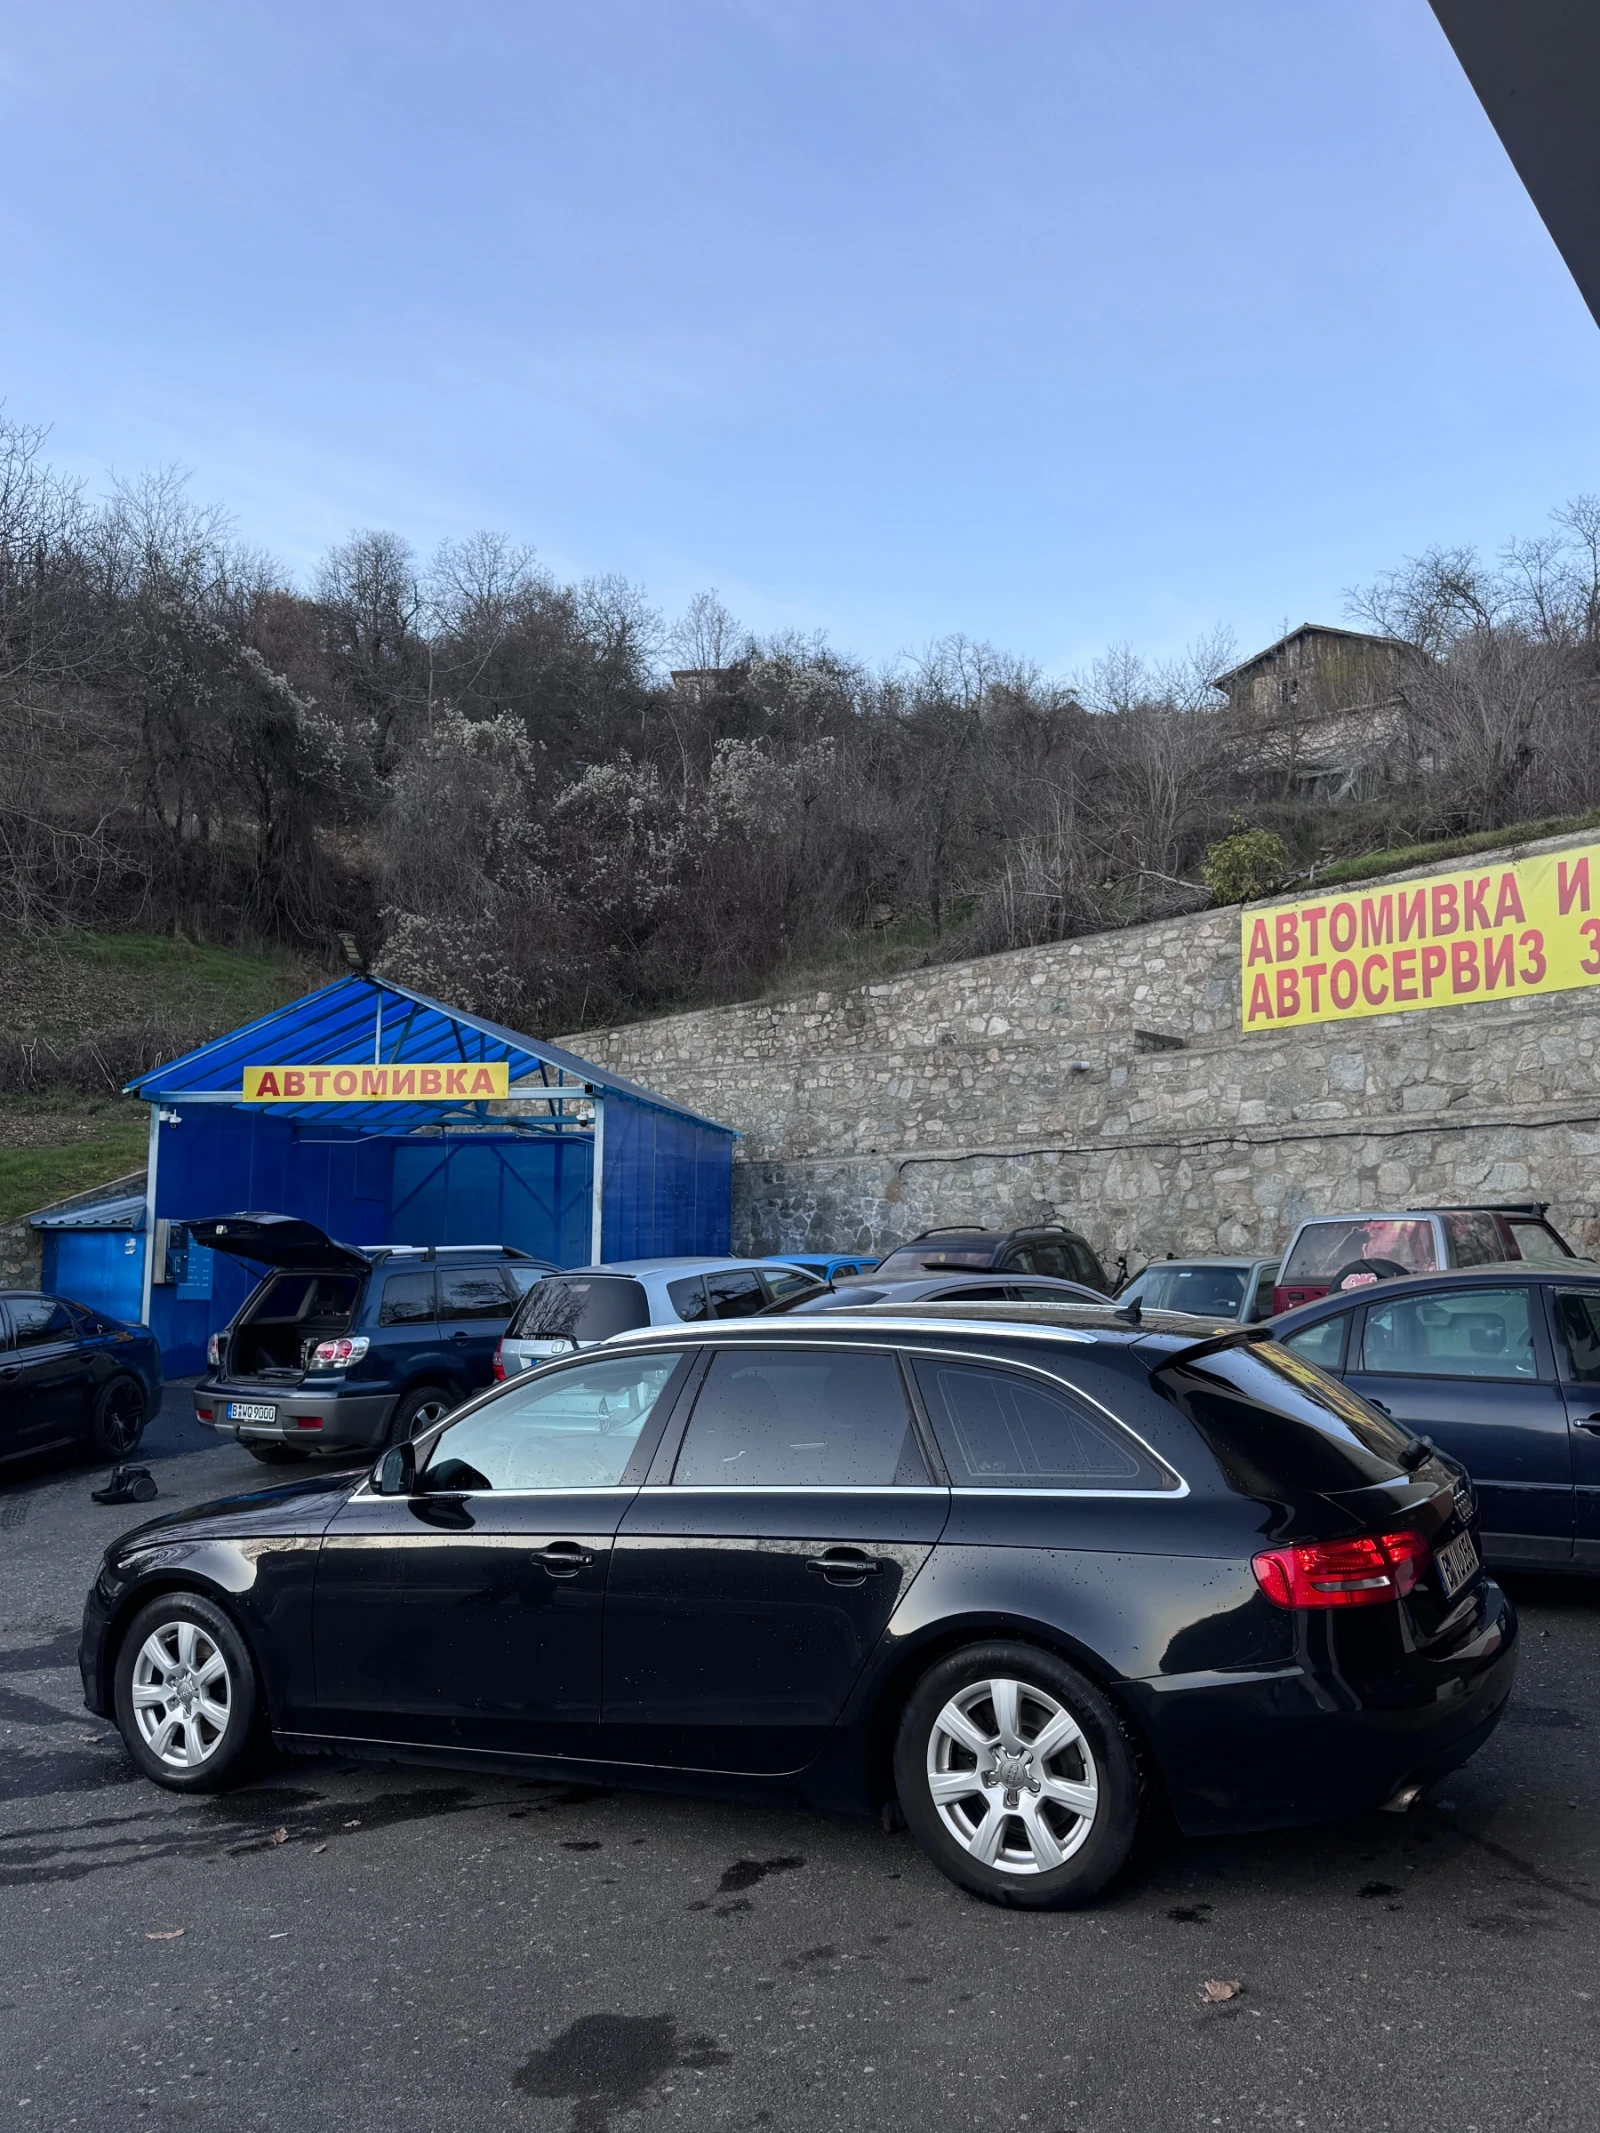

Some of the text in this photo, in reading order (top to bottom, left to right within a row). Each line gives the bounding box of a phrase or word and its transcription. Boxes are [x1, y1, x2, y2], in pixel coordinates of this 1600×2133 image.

[1247, 857, 1590, 967] АВТОМИВКА И
[1248, 929, 1547, 1022] АВТОСЕРВИЗ
[256, 1068, 495, 1097] АВТОМИВКА
